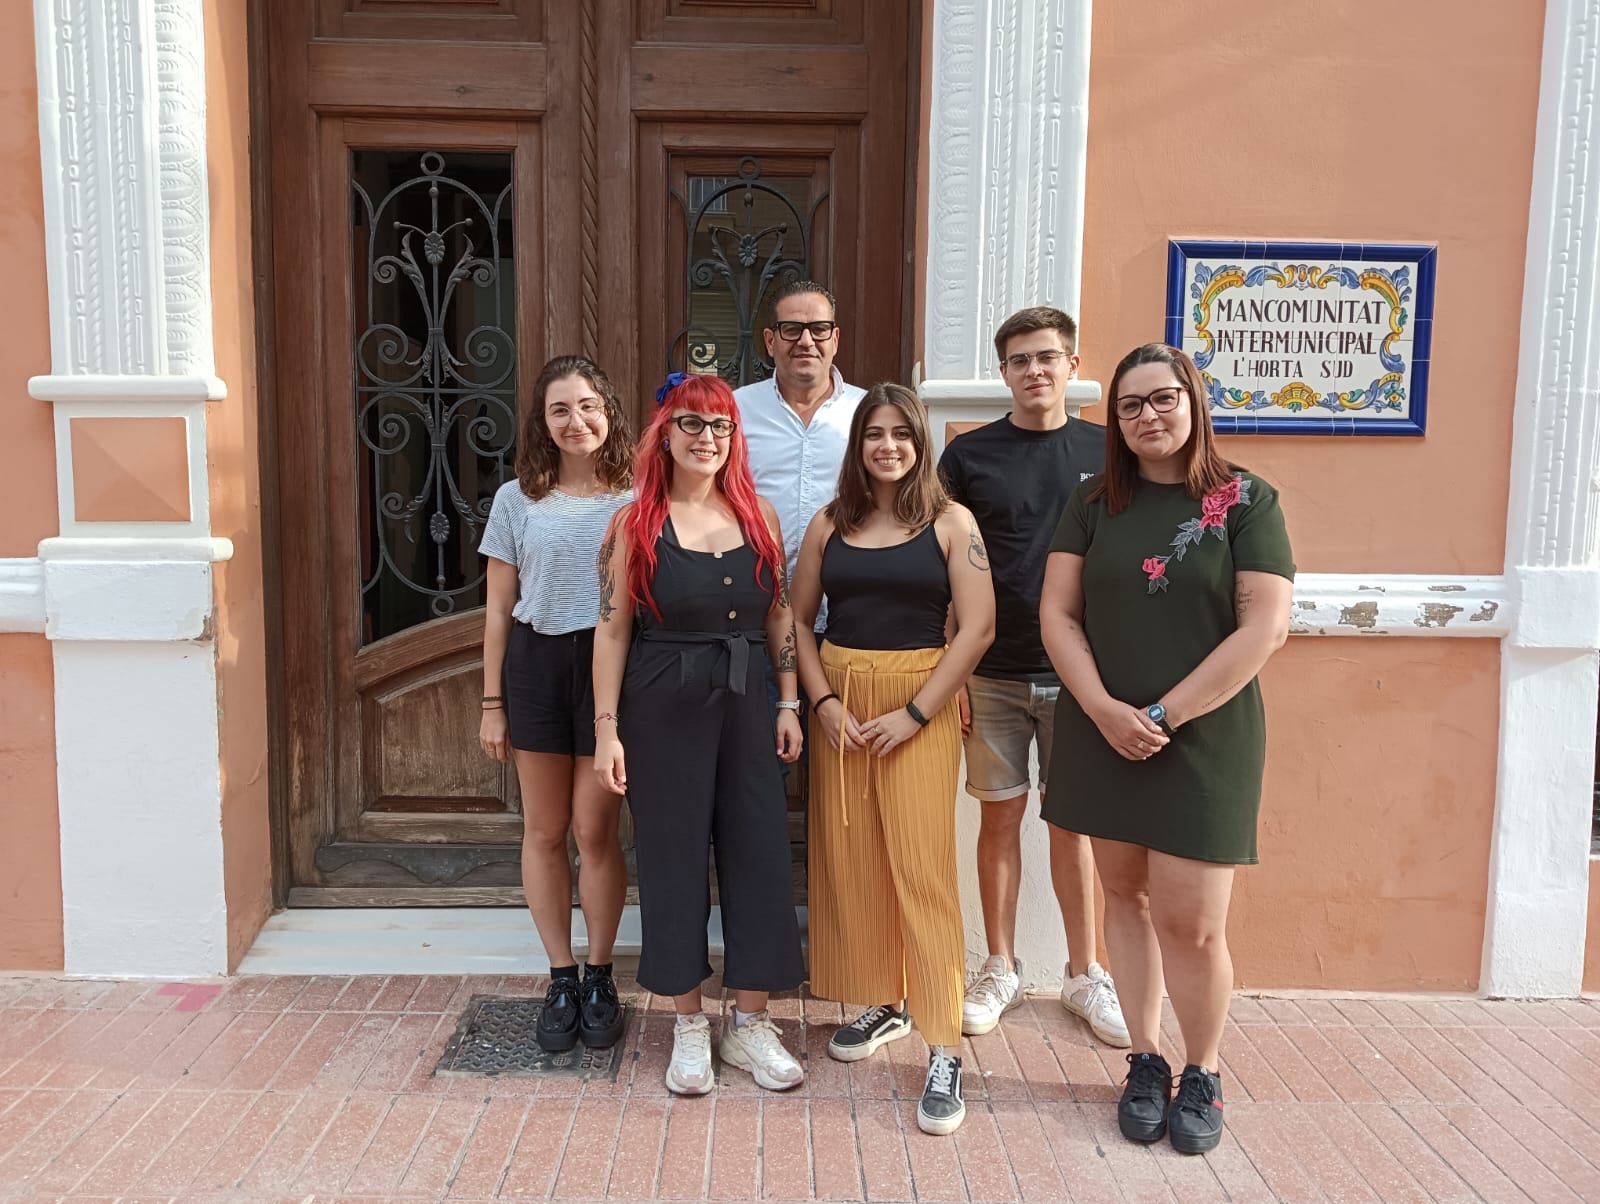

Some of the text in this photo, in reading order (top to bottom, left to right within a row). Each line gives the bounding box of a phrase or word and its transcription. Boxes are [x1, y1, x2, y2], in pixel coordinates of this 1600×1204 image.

[1216, 298, 1386, 325] MANCOMUNITAT
[1217, 329, 1377, 355] INTERMUNICIPAL
[1233, 356, 1354, 379] L'HORTA SUD
